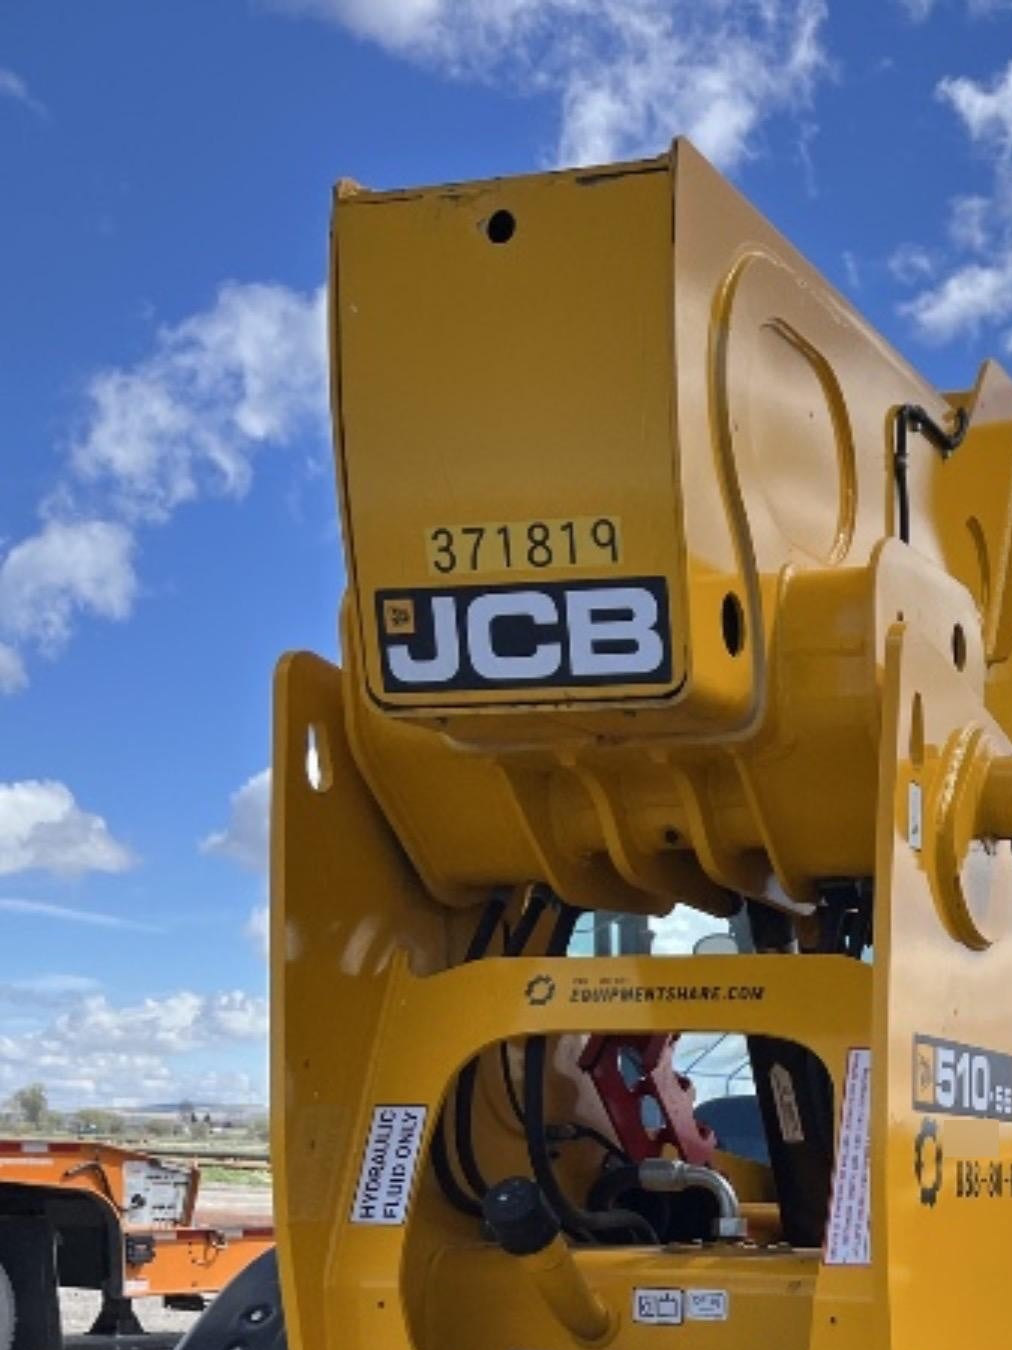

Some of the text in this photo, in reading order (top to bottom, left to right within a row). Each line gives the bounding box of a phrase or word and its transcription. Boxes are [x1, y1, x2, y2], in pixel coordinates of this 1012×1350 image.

[430, 519, 619, 574] 371819
[387, 587, 664, 683] JCB
[569, 986, 766, 1002] EQUIPMENTSHARE.COM
[360, 1109, 397, 1219] HYDRAULIC
[383, 1110, 418, 1219] FLUID ONLY
